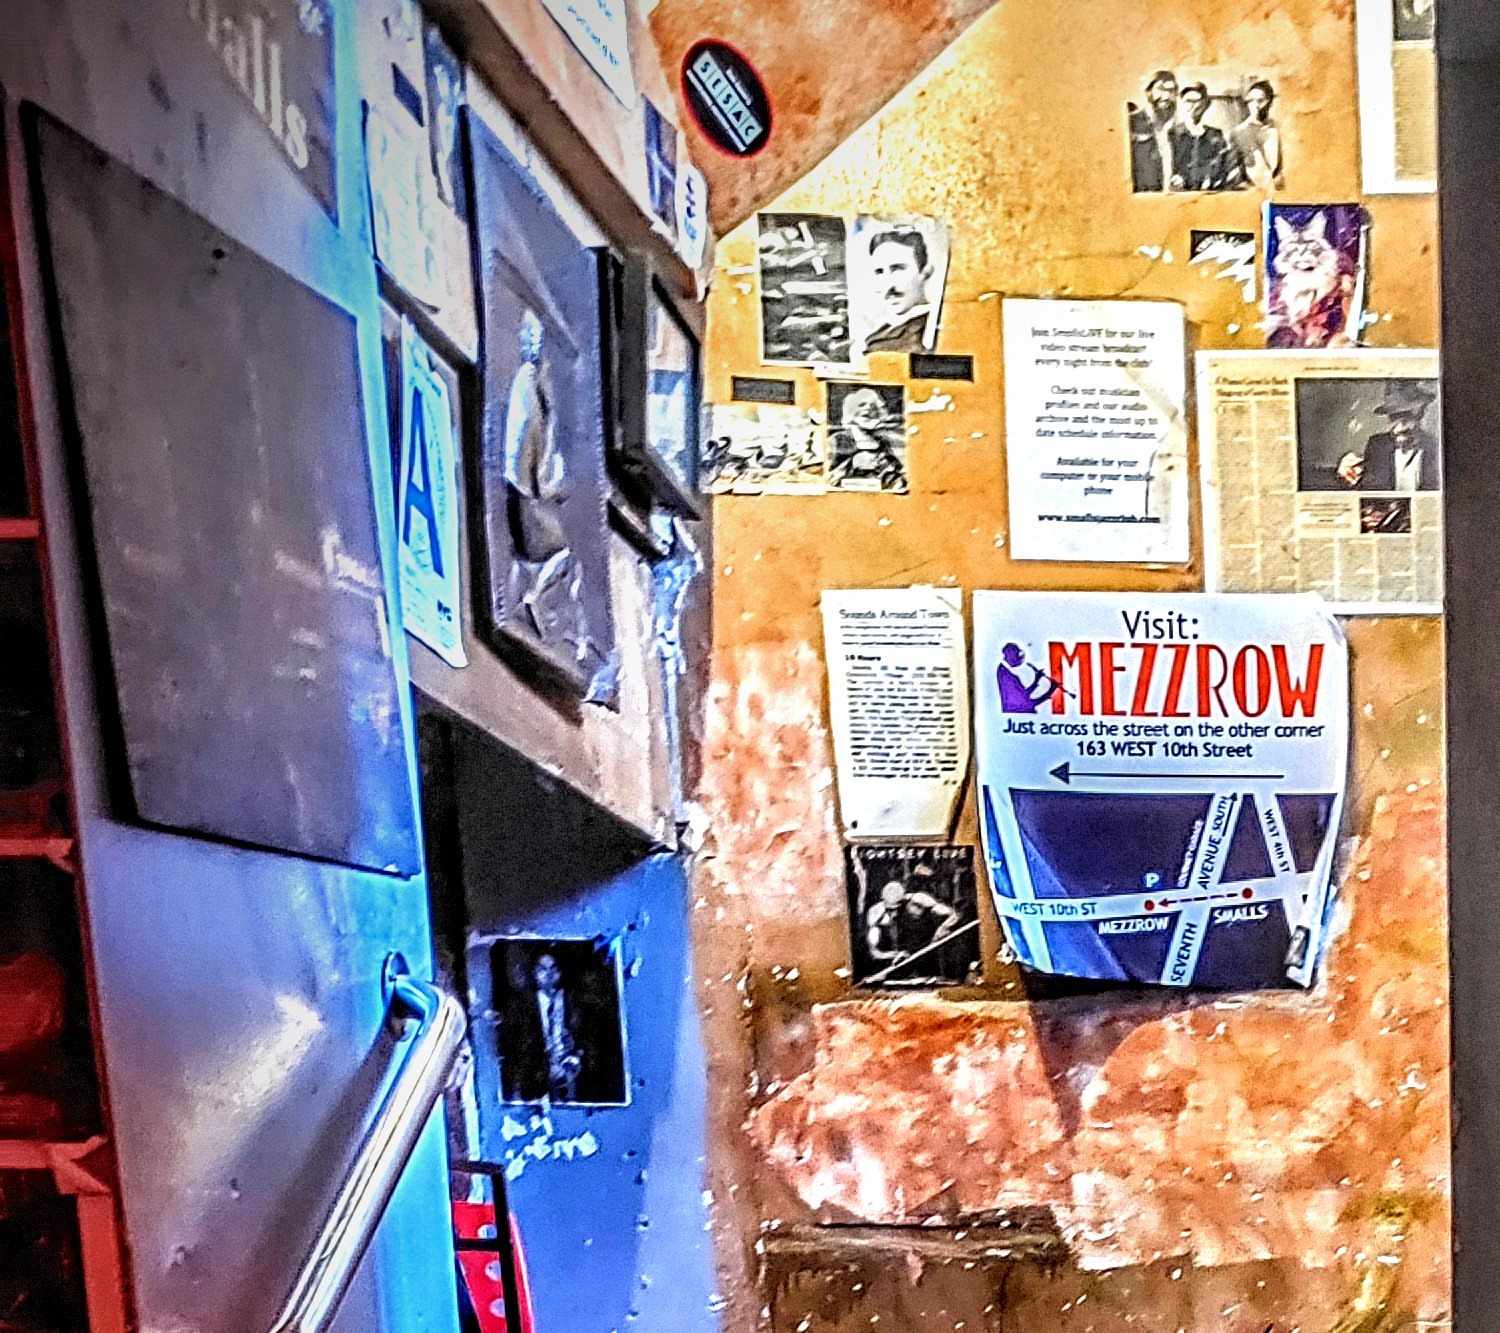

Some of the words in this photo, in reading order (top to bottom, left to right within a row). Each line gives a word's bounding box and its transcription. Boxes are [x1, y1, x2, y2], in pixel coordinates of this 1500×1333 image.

[697, 58, 759, 140] SESAC
[1051, 385, 1078, 395] Check
[1083, 402, 1100, 410] and
[1072, 415, 1089, 424] and
[1092, 415, 1106, 424] the
[1101, 458, 1114, 467] for
[1117, 459, 1139, 469] your
[403, 386, 445, 579] A
[1087, 473, 1098, 481] or
[1100, 473, 1122, 483] your
[1121, 610, 1200, 640] Visit:
[1048, 641, 1325, 718] MEZZROW
[1002, 718, 1035, 736] Just
[1040, 722, 1088, 736] across
[1093, 720, 1119, 737] the
[1122, 722, 1169, 738] street
[1175, 725, 1194, 738] on
[1198, 722, 1225, 738] the
[1229, 722, 1269, 738] other
[1275, 724, 1326, 738] corner
[1077, 740, 1107, 757] 163
[1111, 741, 1157, 757] WEST
[1162, 741, 1199, 758] 10th
[1202, 742, 1254, 758] Street
[1263, 808, 1280, 838] WEST
[1273, 841, 1285, 859] 4th
[1279, 860, 1291, 873] ST
[1146, 872, 1161, 888] P
[1171, 922, 1198, 983] SEVENTH
[1197, 835, 1222, 890] AVENUE
[1213, 795, 1229, 832] SOUTH
[1013, 902, 1046, 915] WEST
[1048, 902, 1079, 916] 10th
[1081, 902, 1098, 915] ST
[1213, 904, 1270, 924] SMALLS
[1098, 916, 1171, 935] MEZZROW
